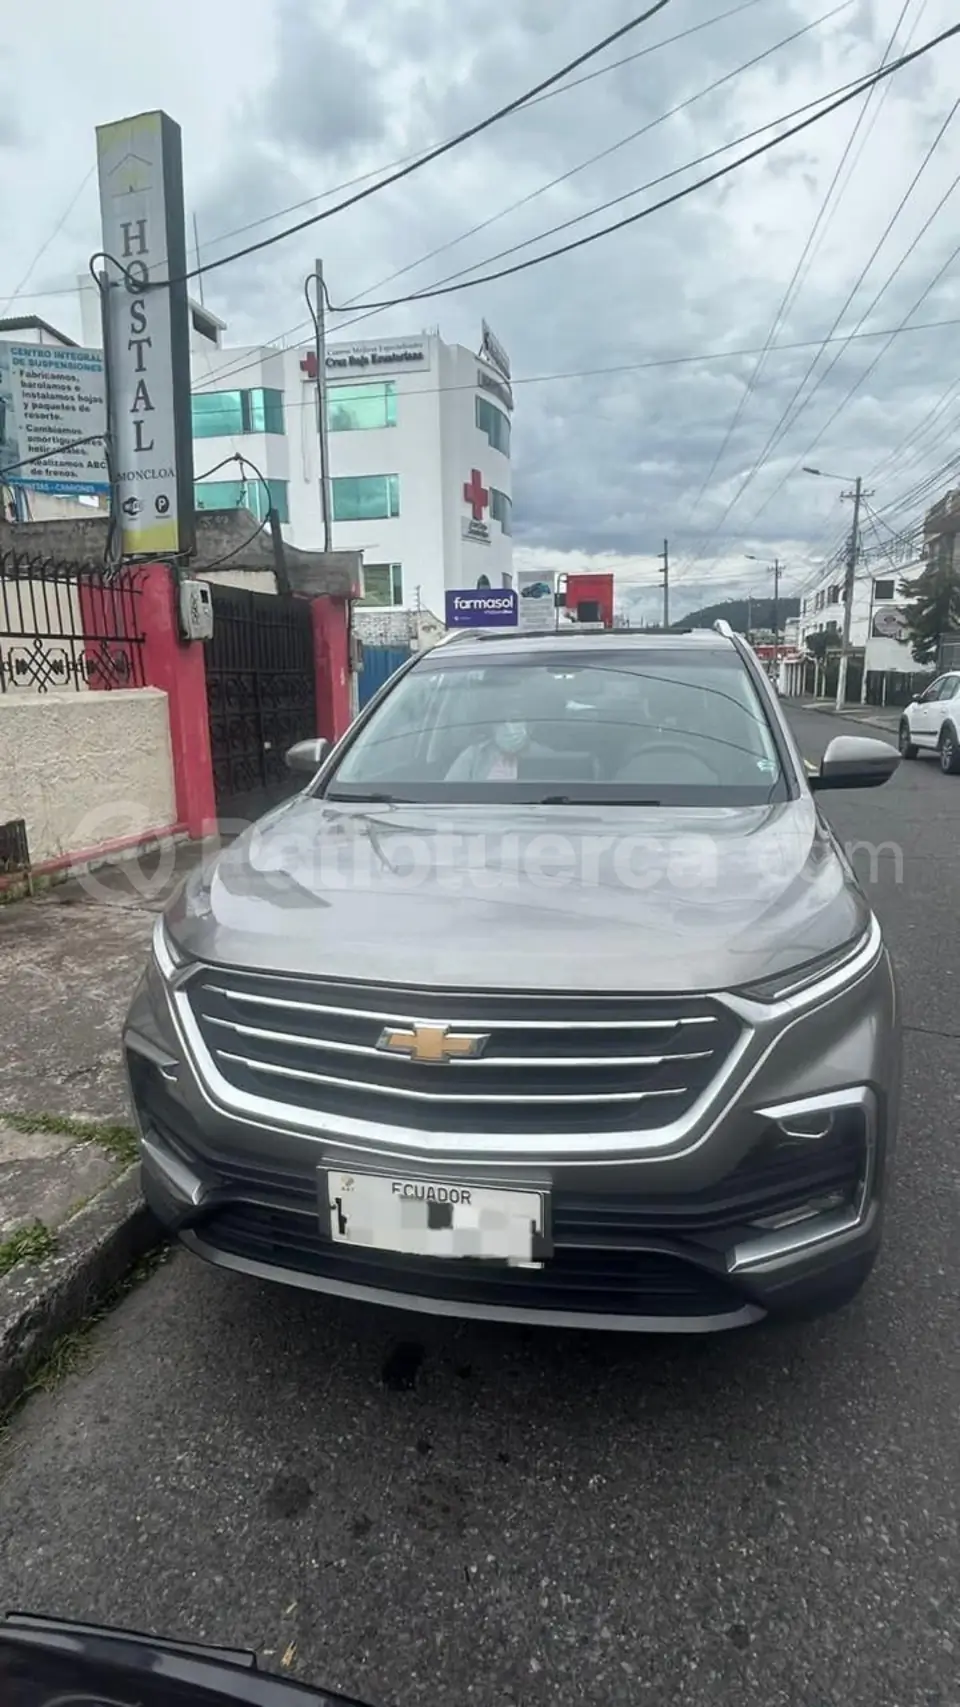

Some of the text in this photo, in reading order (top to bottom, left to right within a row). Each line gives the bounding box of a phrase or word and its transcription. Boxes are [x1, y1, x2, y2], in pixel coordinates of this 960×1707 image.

[119, 219, 155, 453] HOSTAL
[10, 347, 102, 362] CENTRO INTEGRAL
[12, 357, 103, 373] DE SUSPENSIONES
[19, 370, 80, 383] Fabricamos,
[22, 391, 103, 405] instalamos hojas
[23, 402, 91, 413] y paquetes de
[27, 436, 103, 447] amortiguares
[30, 468, 43, 476] de
[87, 461, 106, 469] ABC
[116, 467, 175, 482] MONCLOA
[453, 595, 514, 610] farmasol
[391, 1182, 472, 1205] ECUADOR
